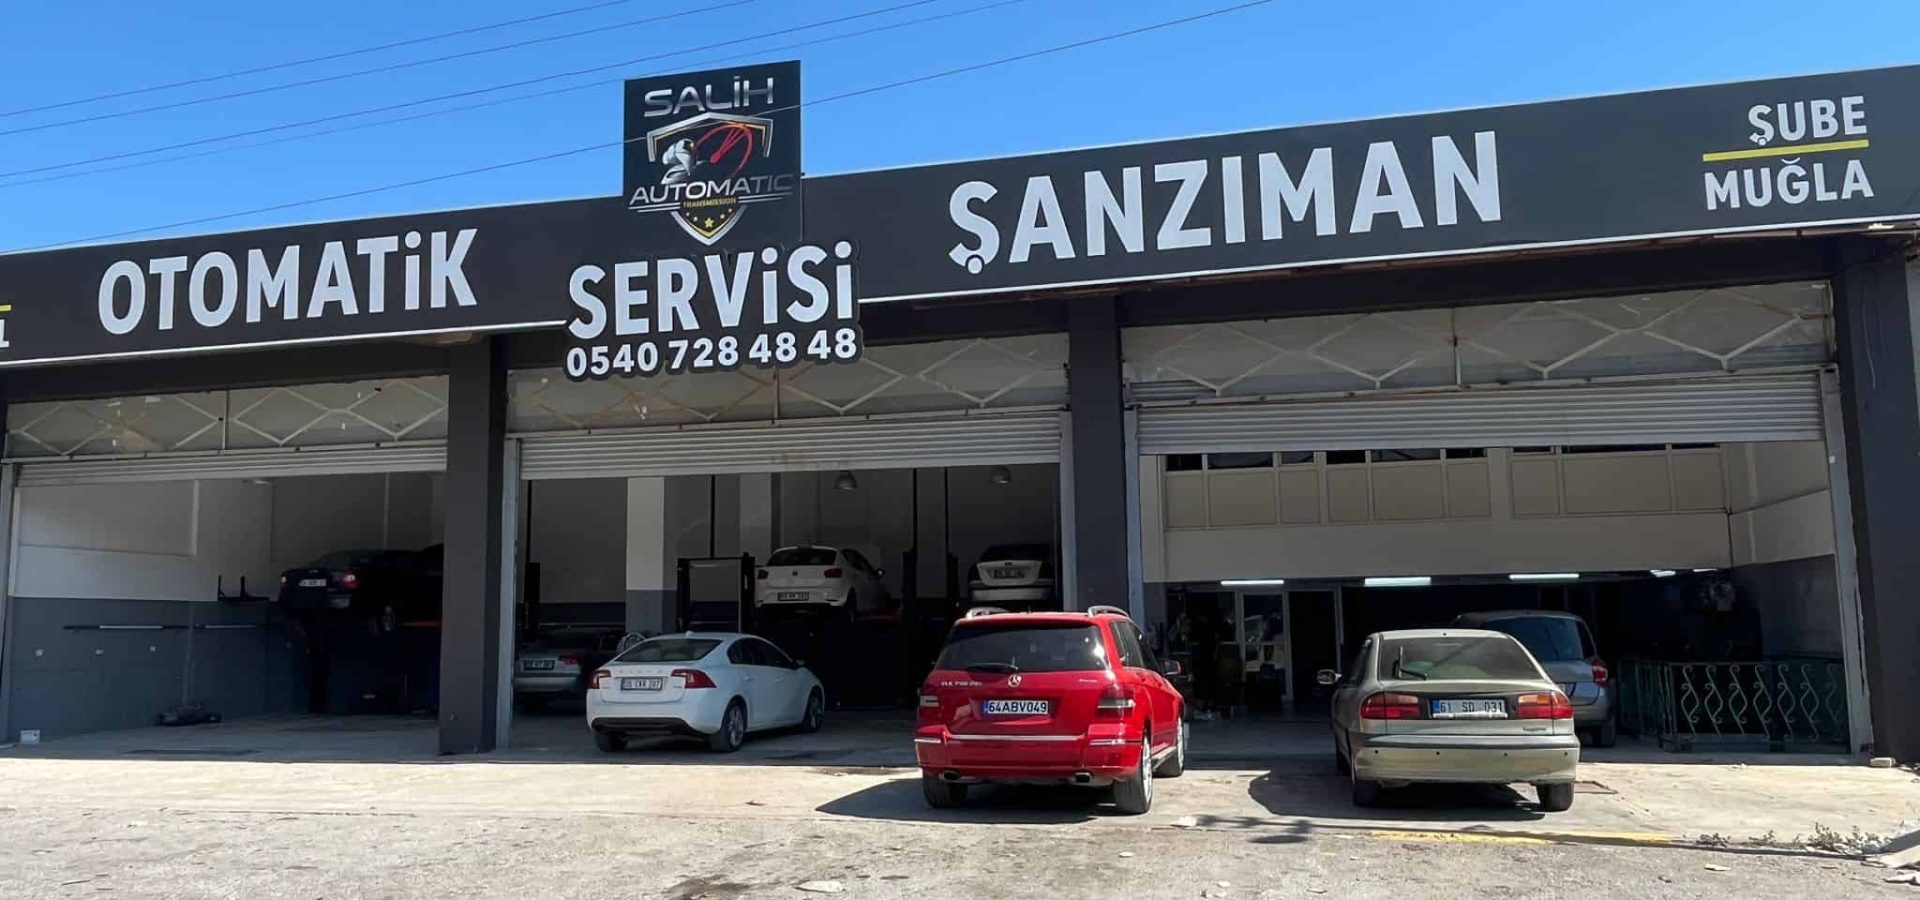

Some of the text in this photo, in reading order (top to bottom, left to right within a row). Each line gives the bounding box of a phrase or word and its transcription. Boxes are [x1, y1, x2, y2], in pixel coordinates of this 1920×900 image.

[644, 75, 773, 117] SALİH
[1748, 95, 1867, 146] ŞUBE
[629, 173, 794, 205] AUTOMATIC
[682, 197, 737, 208] TRANSMISSION
[948, 131, 1501, 274] ŞANZIMAN
[1704, 157, 1875, 211] MUĞLA
[566, 328, 857, 377] 0540 728 48 48
[988, 701, 1048, 713] 64ABV049
